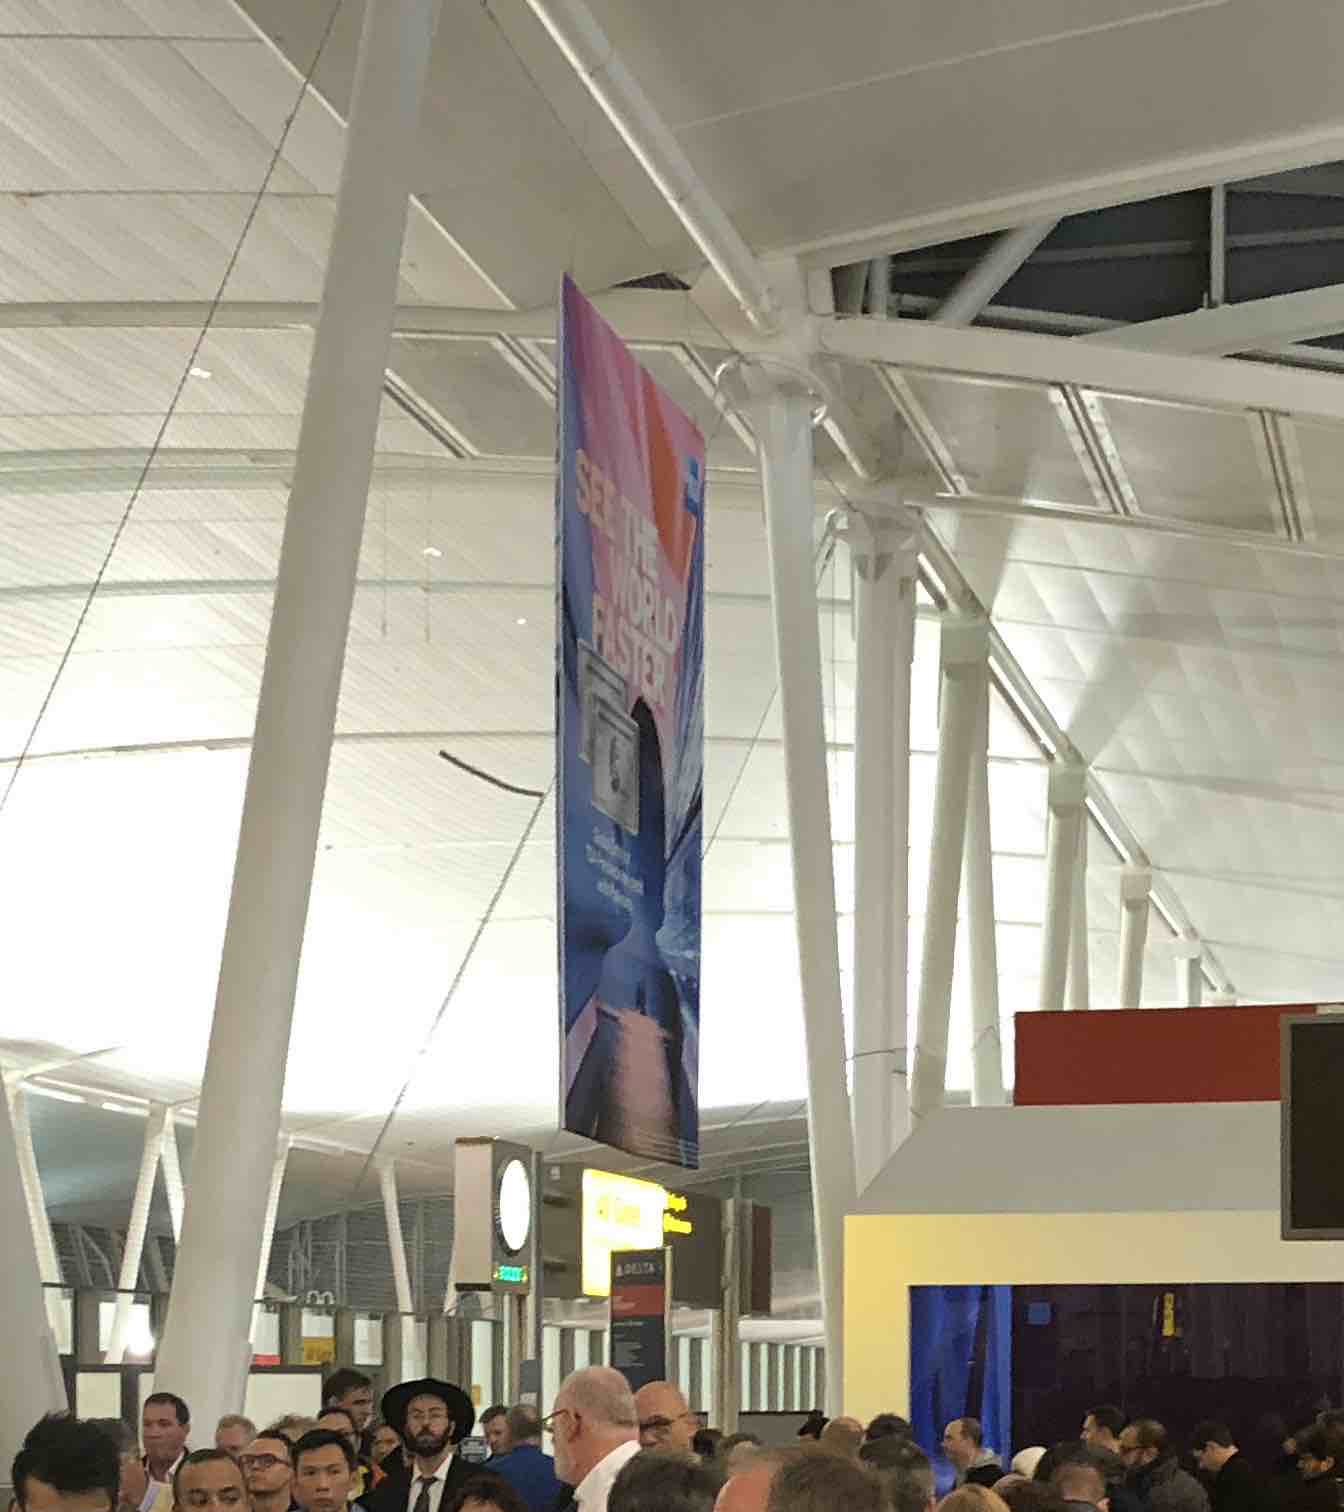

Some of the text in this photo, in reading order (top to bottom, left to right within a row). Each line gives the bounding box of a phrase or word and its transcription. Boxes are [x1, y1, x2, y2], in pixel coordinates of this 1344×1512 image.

[576, 448, 657, 586] SEE THE
[592, 593, 664, 706] FASTER
[609, 544, 677, 658] WORLD
[624, 1262, 656, 1275] DELTA
